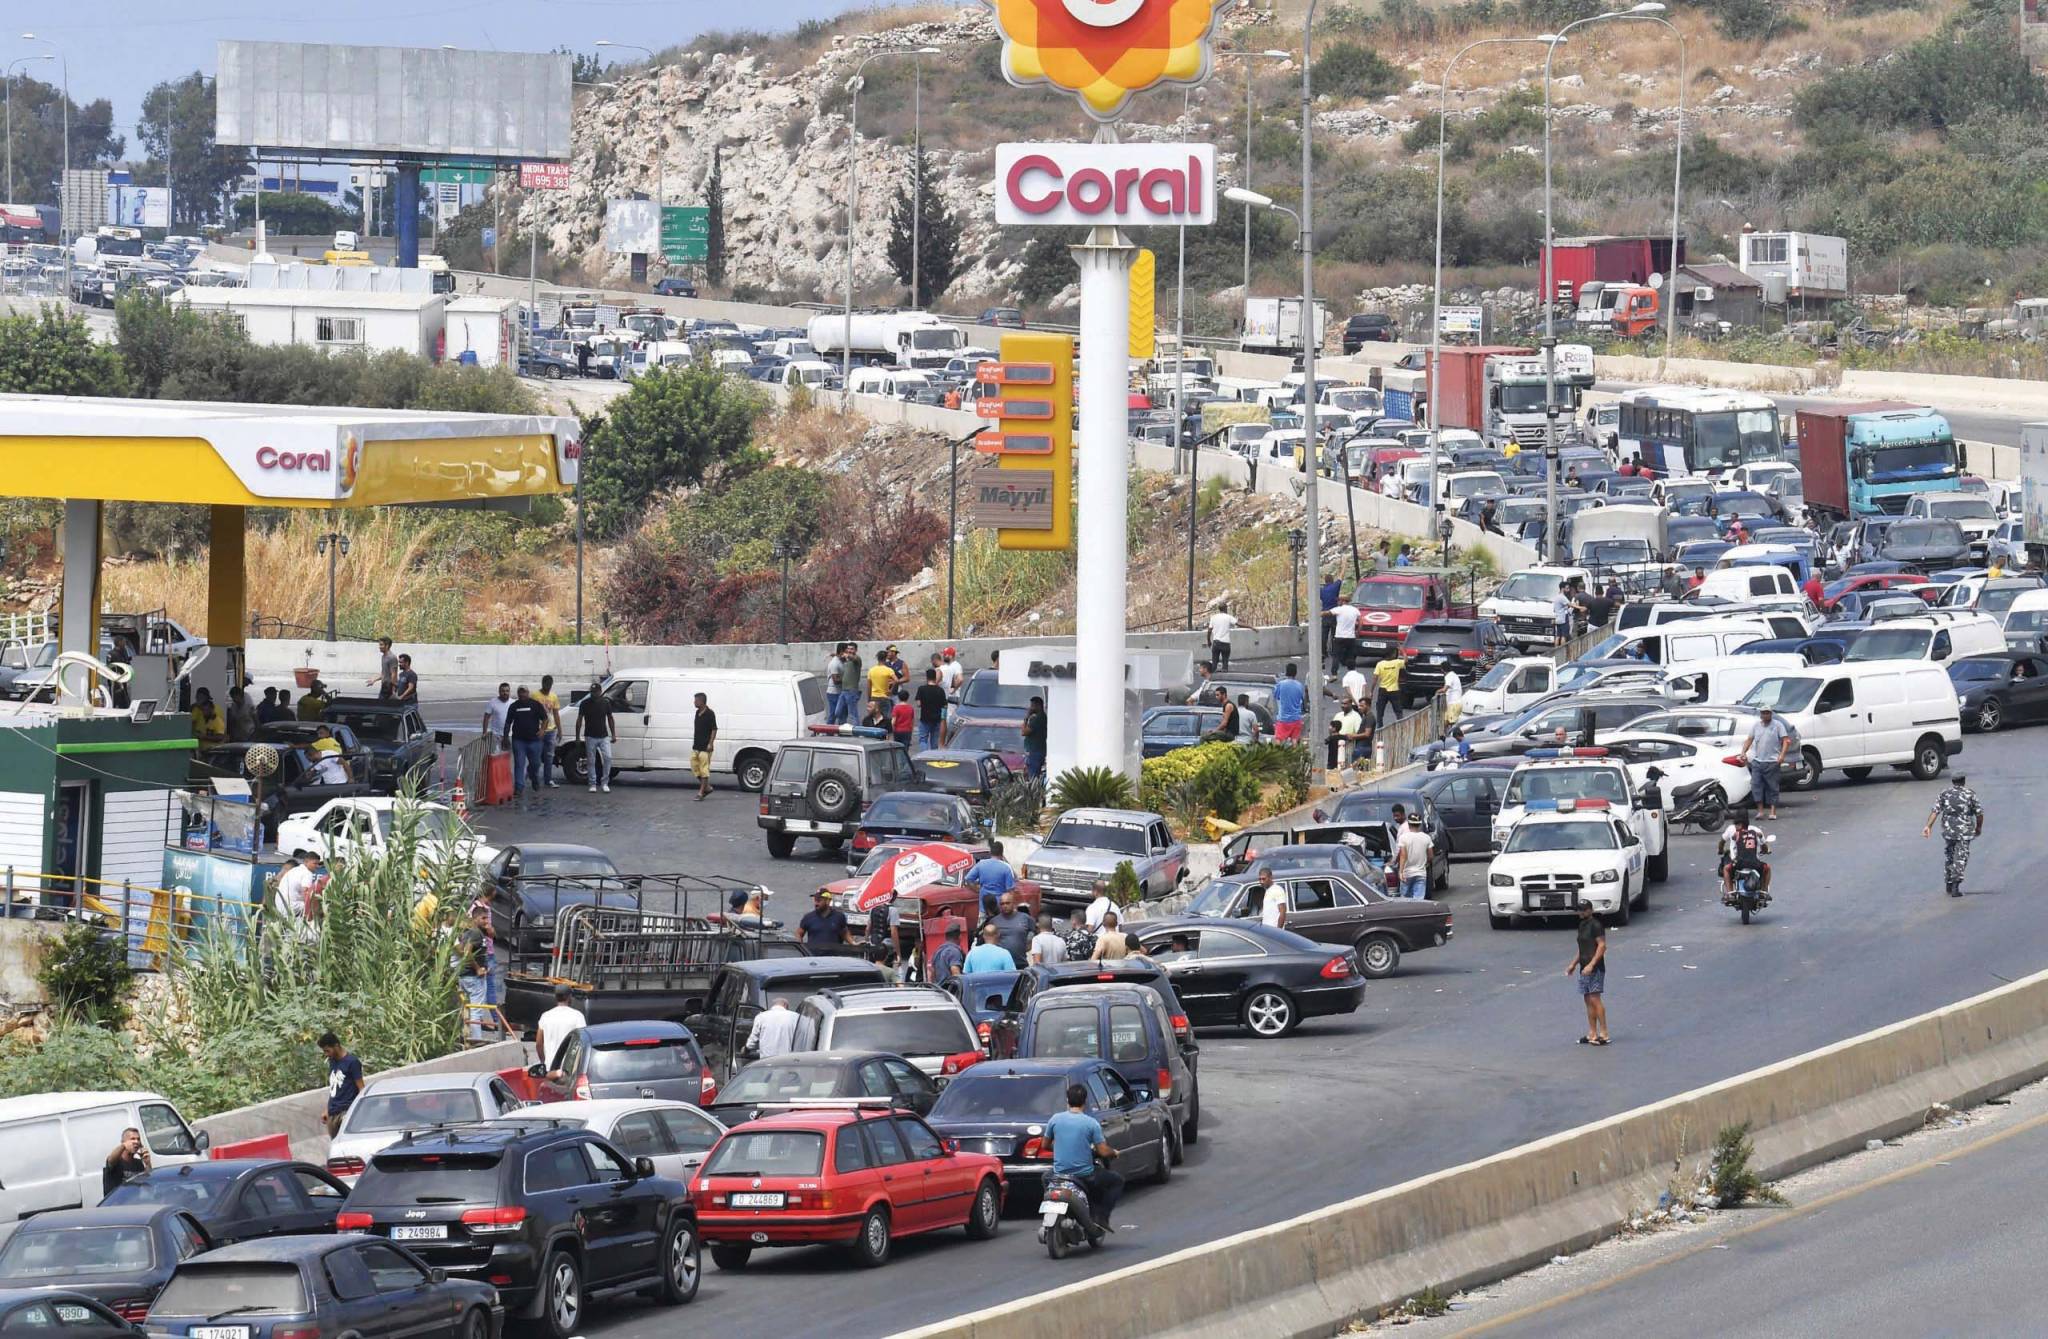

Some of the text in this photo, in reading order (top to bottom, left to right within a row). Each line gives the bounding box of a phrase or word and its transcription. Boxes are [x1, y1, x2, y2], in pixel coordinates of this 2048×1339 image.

[522, 164, 545, 174] MEDIA
[1006, 154, 1202, 215] Coral
[1880, 439, 1916, 449] Mercedes
[256, 446, 331, 472] Coral
[980, 486, 1047, 507] Mayyil
[405, 1209, 426, 1219] Jeep
[397, 1227, 441, 1238] S 249984
